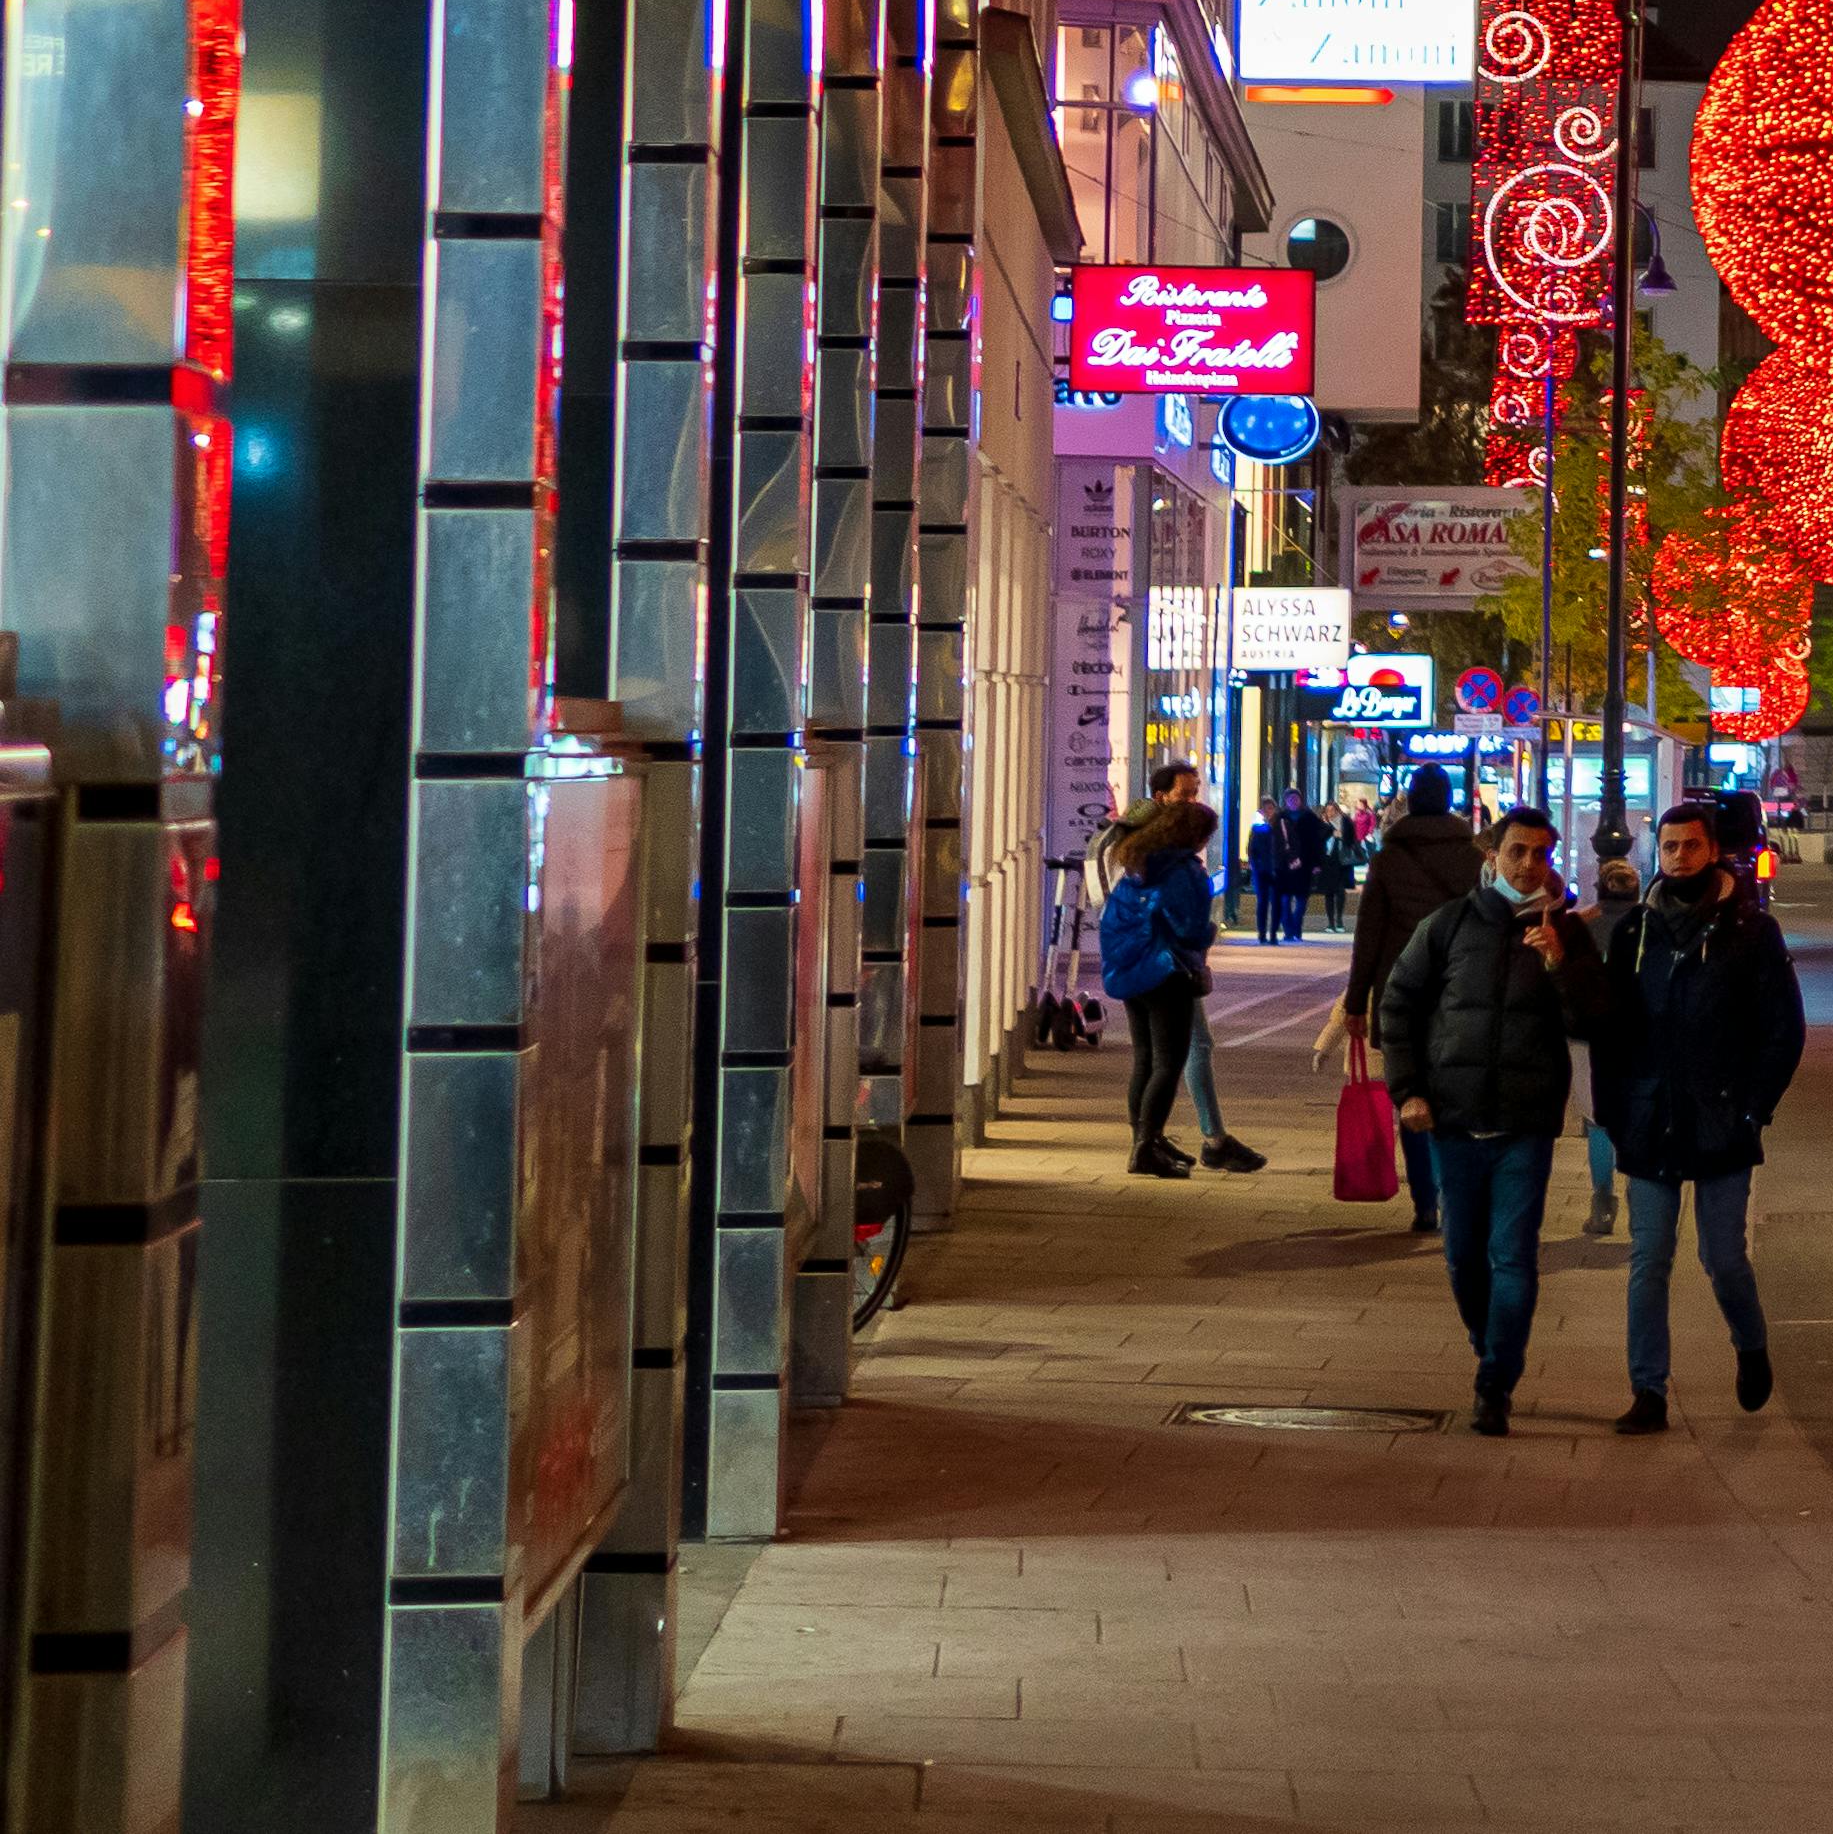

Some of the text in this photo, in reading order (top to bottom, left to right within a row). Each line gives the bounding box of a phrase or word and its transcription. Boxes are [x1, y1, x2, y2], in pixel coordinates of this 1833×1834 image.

[1119, 274, 1268, 309] Ristorante
[1087, 327, 1299, 369] Dai Fratelli
[1070, 526, 1131, 538] BURTON
[1242, 599, 1316, 617] ALYSSA
[1242, 624, 1343, 643] SCHWARZ
[1240, 650, 1296, 659] AUSTRIA
